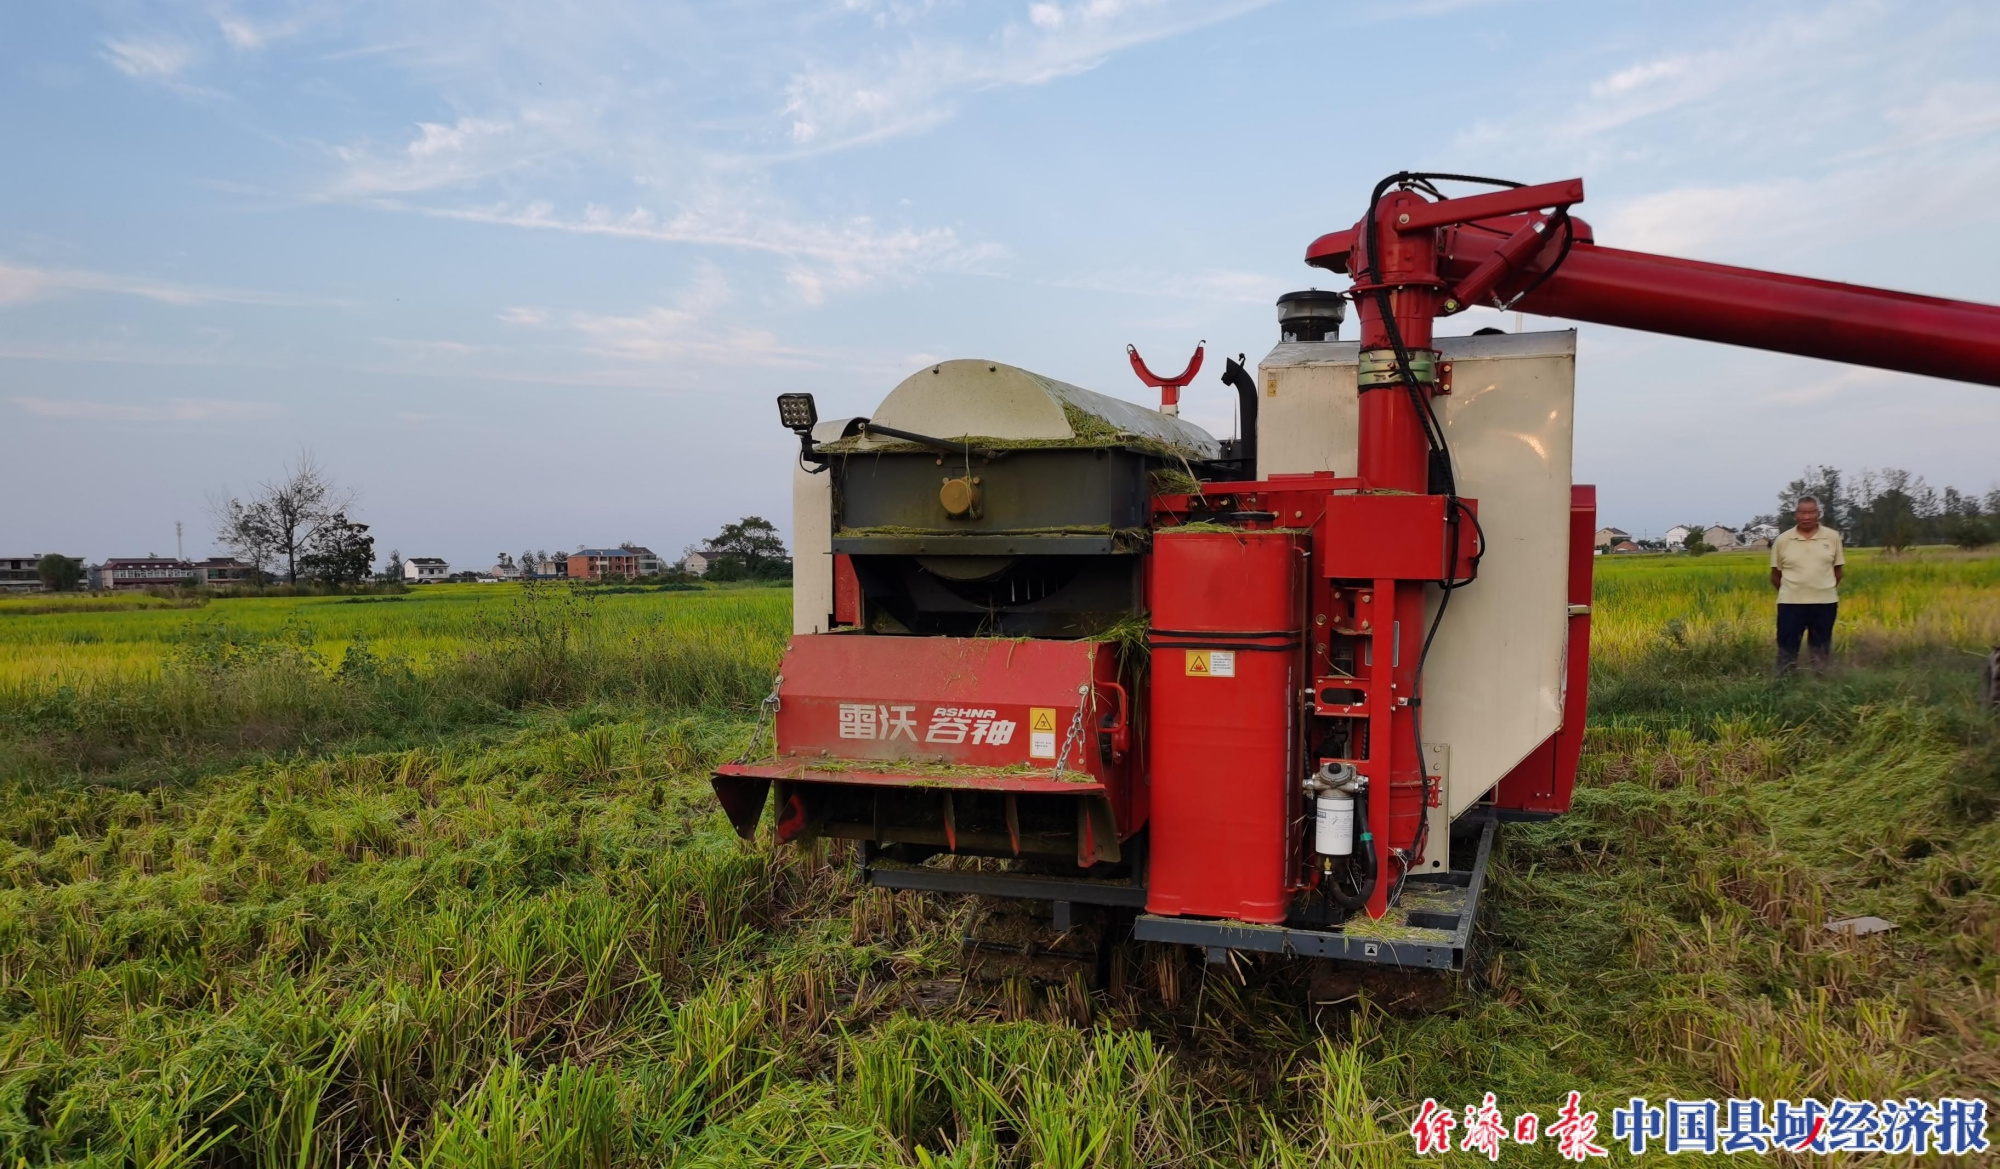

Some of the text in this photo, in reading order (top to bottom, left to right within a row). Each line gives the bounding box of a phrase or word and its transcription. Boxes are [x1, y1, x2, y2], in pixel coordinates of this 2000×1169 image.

[839, 703, 1017, 746] 雷沃 谷神
[933, 707, 997, 719] ASHNA
